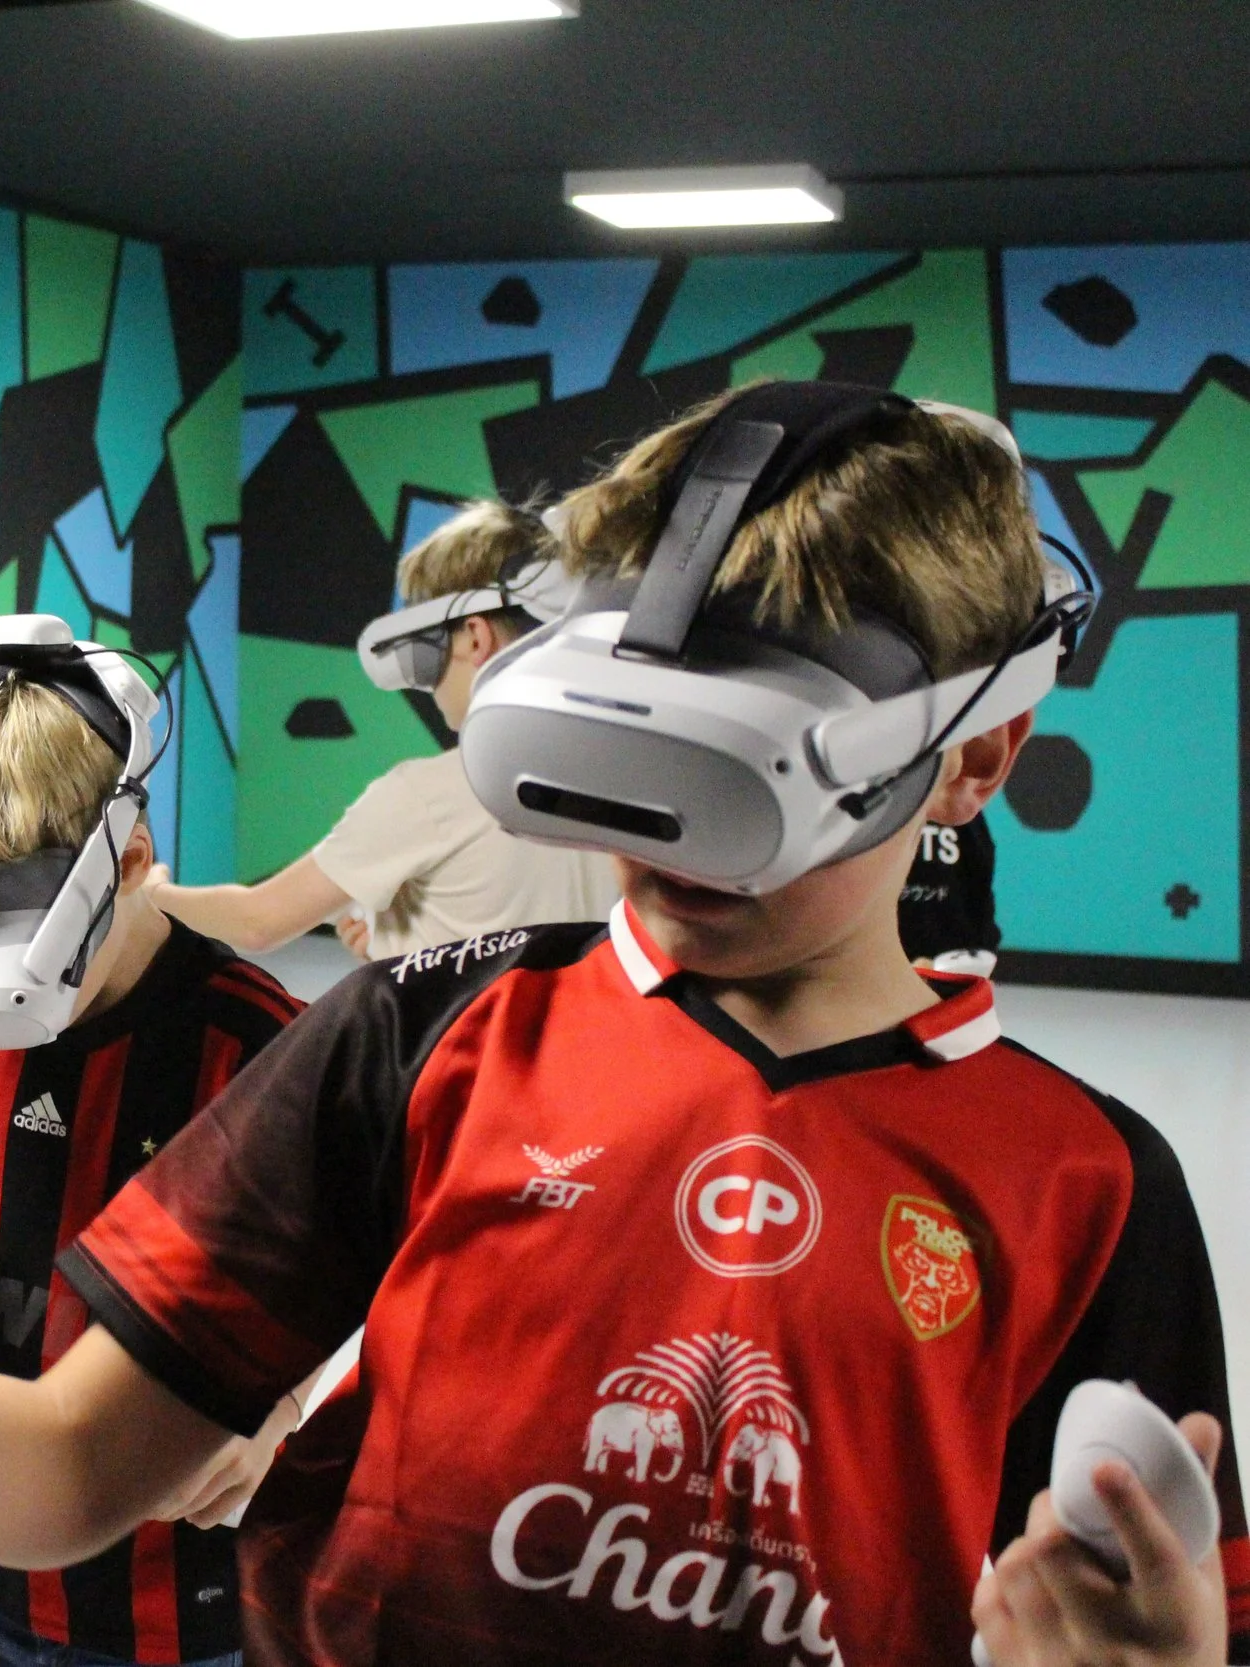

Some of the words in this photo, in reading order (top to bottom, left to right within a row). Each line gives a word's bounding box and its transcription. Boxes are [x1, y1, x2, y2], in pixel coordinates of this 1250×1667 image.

[390, 929, 531, 984] AirAsia
[13, 1114, 67, 1137] adidas
[511, 1177, 596, 1210] FBT
[697, 1175, 799, 1235] CP
